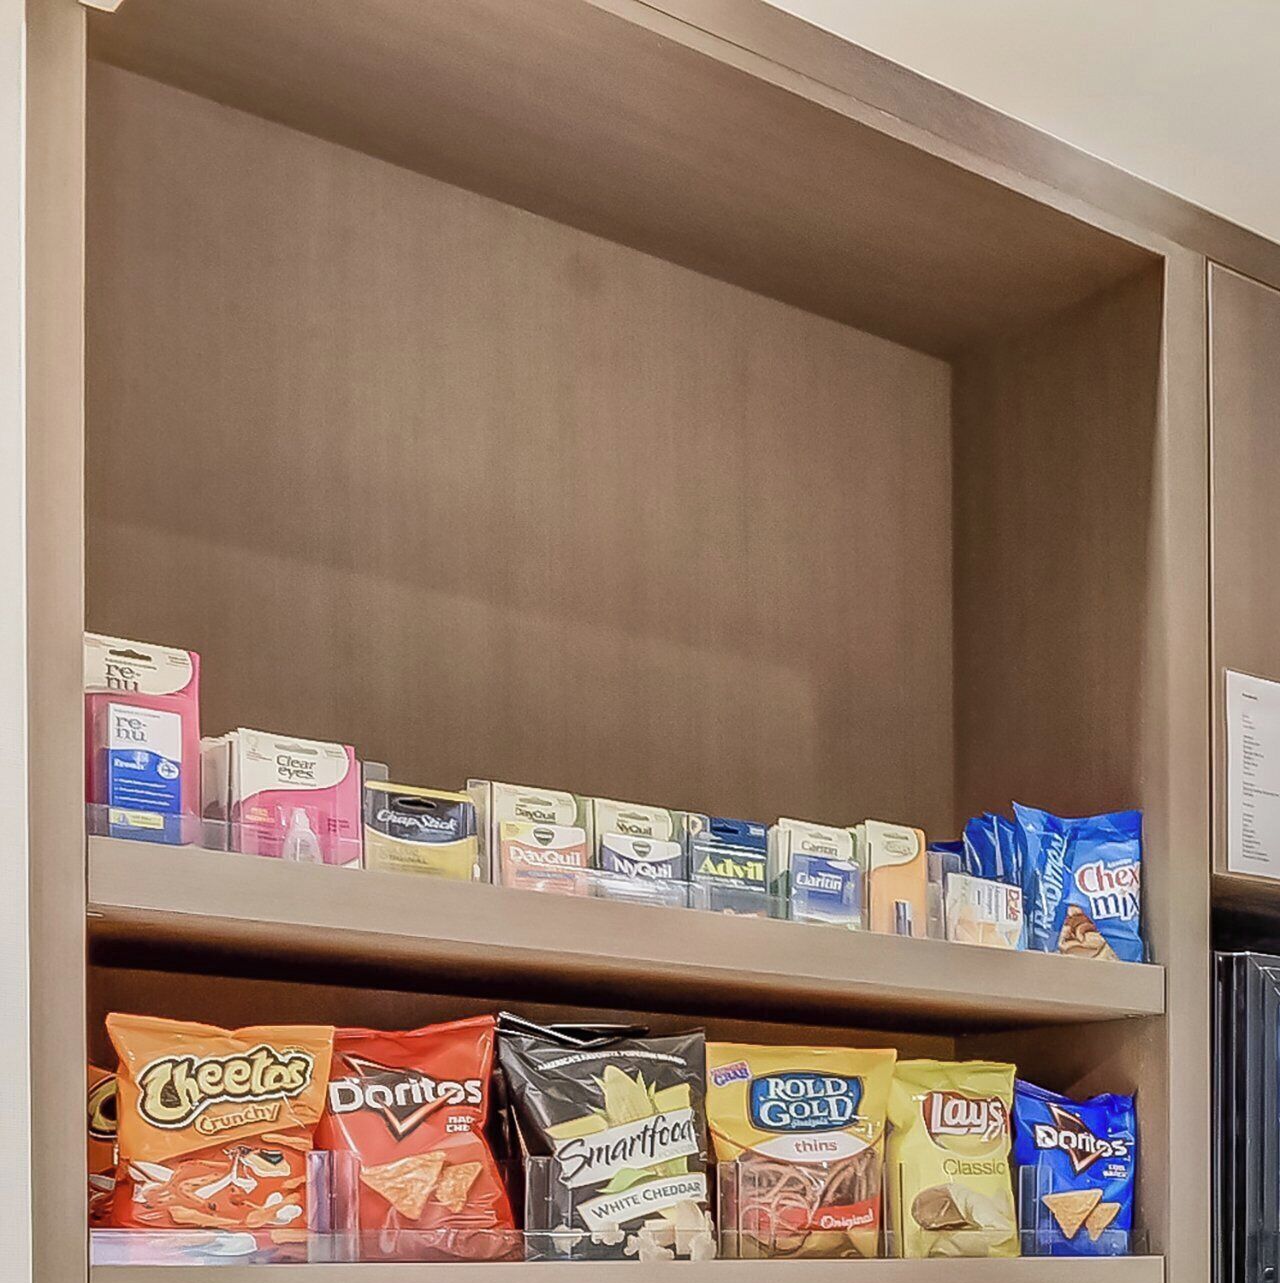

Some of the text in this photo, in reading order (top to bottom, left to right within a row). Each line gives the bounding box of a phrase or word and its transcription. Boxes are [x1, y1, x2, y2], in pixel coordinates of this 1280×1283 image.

[277, 755, 316, 770] Clear
[278, 766, 315, 780] eyes
[510, 846, 581, 867] DayQuil
[613, 856, 673, 880] NyQuil
[699, 856, 765, 882] Advil
[796, 871, 842, 891] Claritin
[1077, 861, 1140, 894] Chex
[1091, 891, 1140, 919] mix
[142, 1049, 310, 1123] Cheetos
[329, 1076, 482, 1113] Doritos
[766, 1077, 849, 1099] ROLD
[198, 1102, 281, 1135] Crunchy
[760, 1096, 853, 1127] GOLD
[557, 1118, 696, 1182] Smartfood
[794, 1139, 838, 1153] thins
[1034, 1124, 1128, 1158] Doritos
[943, 1158, 1006, 1176] Classic
[591, 1181, 703, 1220] WHITE CHEDDAR
[820, 1210, 874, 1230] Original
